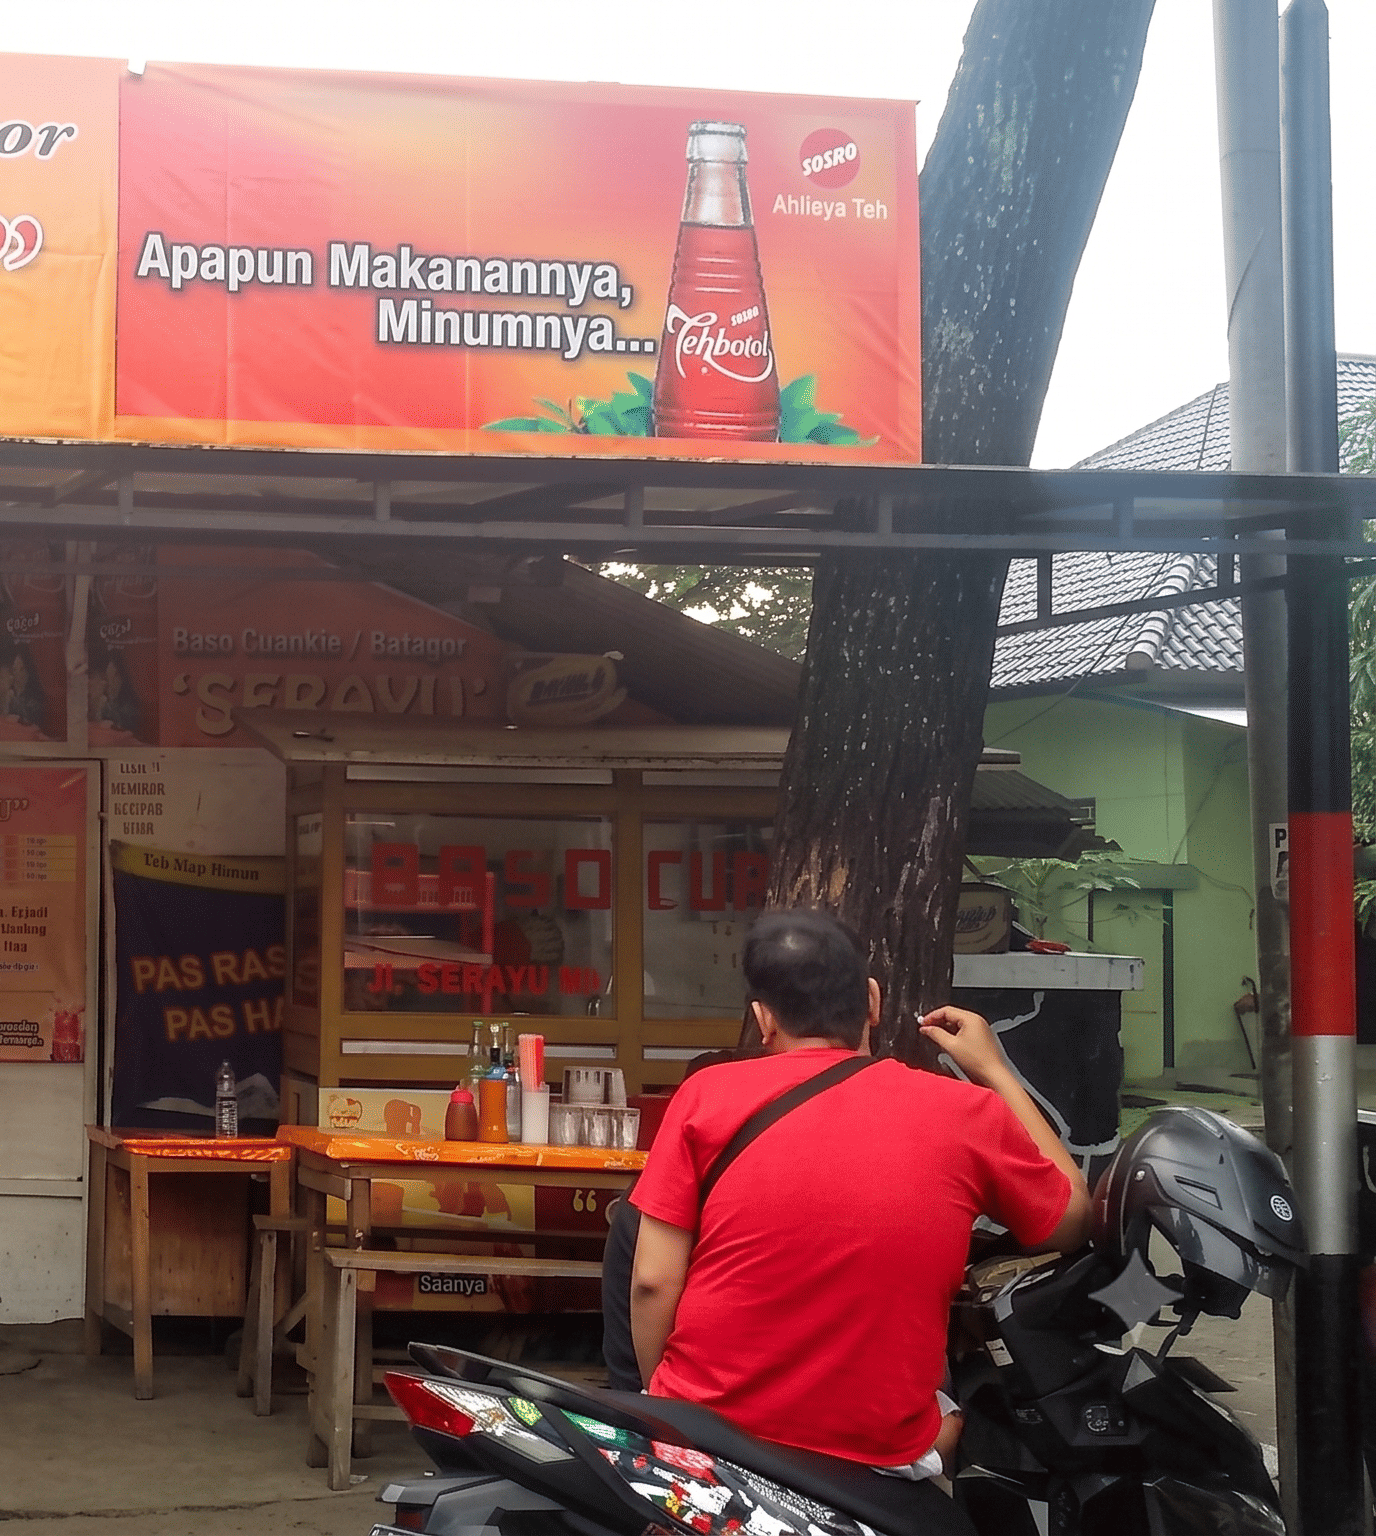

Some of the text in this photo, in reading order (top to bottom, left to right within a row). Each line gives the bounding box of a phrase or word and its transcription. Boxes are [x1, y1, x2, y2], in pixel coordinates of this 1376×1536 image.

[801, 142, 857, 176] SOSRO
[851, 198, 888, 219] Teh
[136, 232, 634, 307] Apapun Makanannya,
[378, 299, 656, 360] Minumnya...
[666, 303, 773, 384] Tehbotol
[172, 627, 234, 655] Baso
[241, 627, 342, 656] Cuankie
[371, 630, 468, 662] Batagor
[132, 956, 204, 992] PAS
[417, 963, 549, 995] SERAYU
[164, 1005, 235, 1040] PAS
[420, 1275, 485, 1297] Saanya
